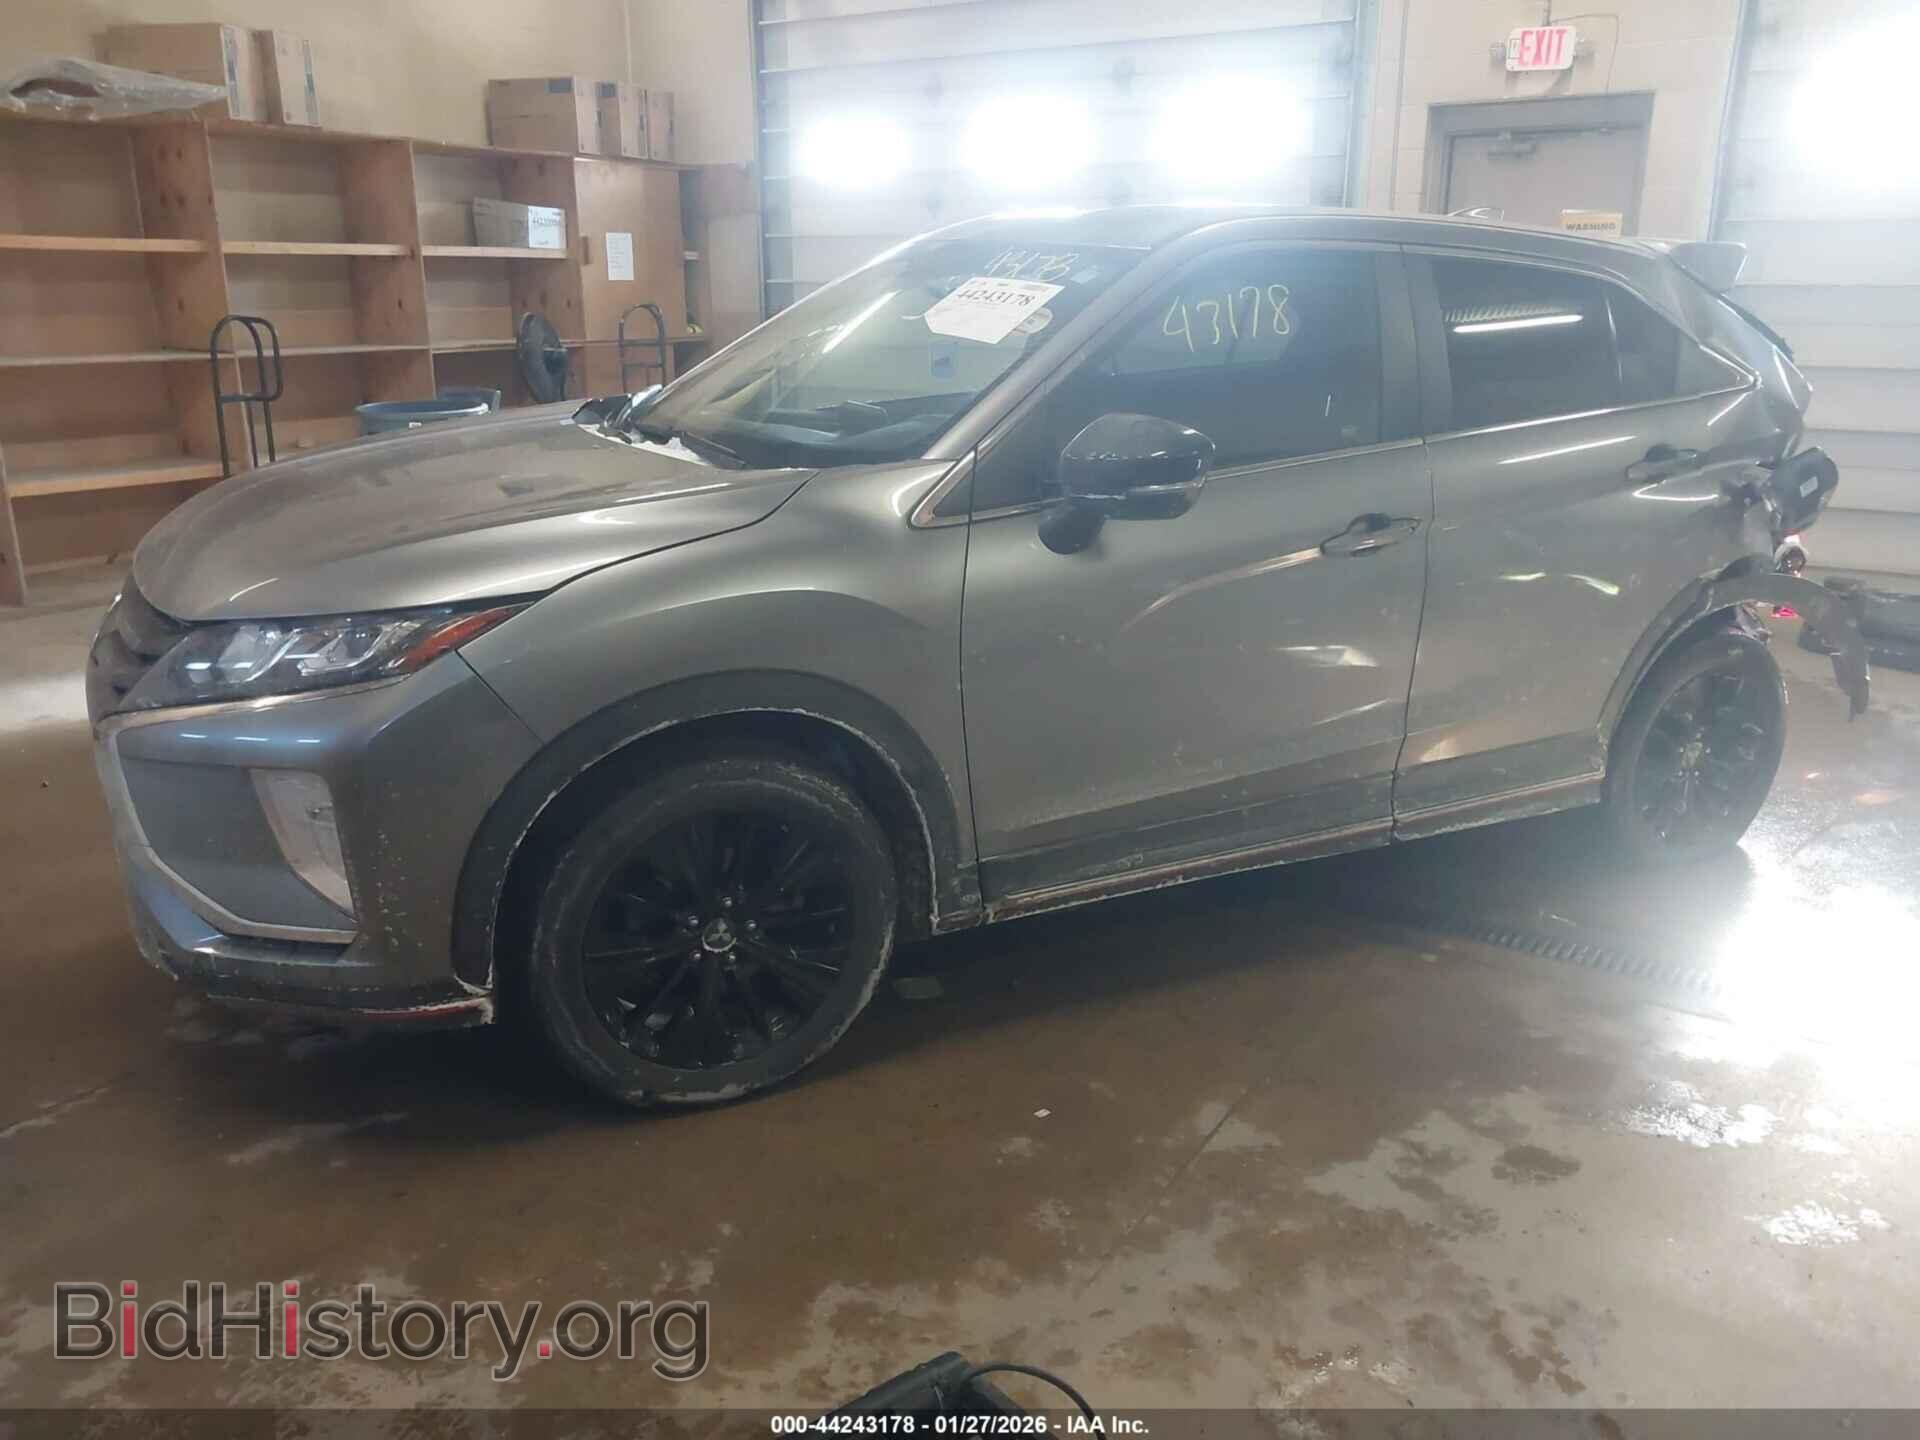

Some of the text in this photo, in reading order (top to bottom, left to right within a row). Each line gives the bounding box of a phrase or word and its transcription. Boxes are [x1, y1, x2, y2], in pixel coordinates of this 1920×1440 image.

[1519, 29, 1567, 65] EXIT
[1566, 223, 1616, 231] WARNING
[957, 288, 1036, 306] 44243178
[1163, 284, 1290, 352] 43178
